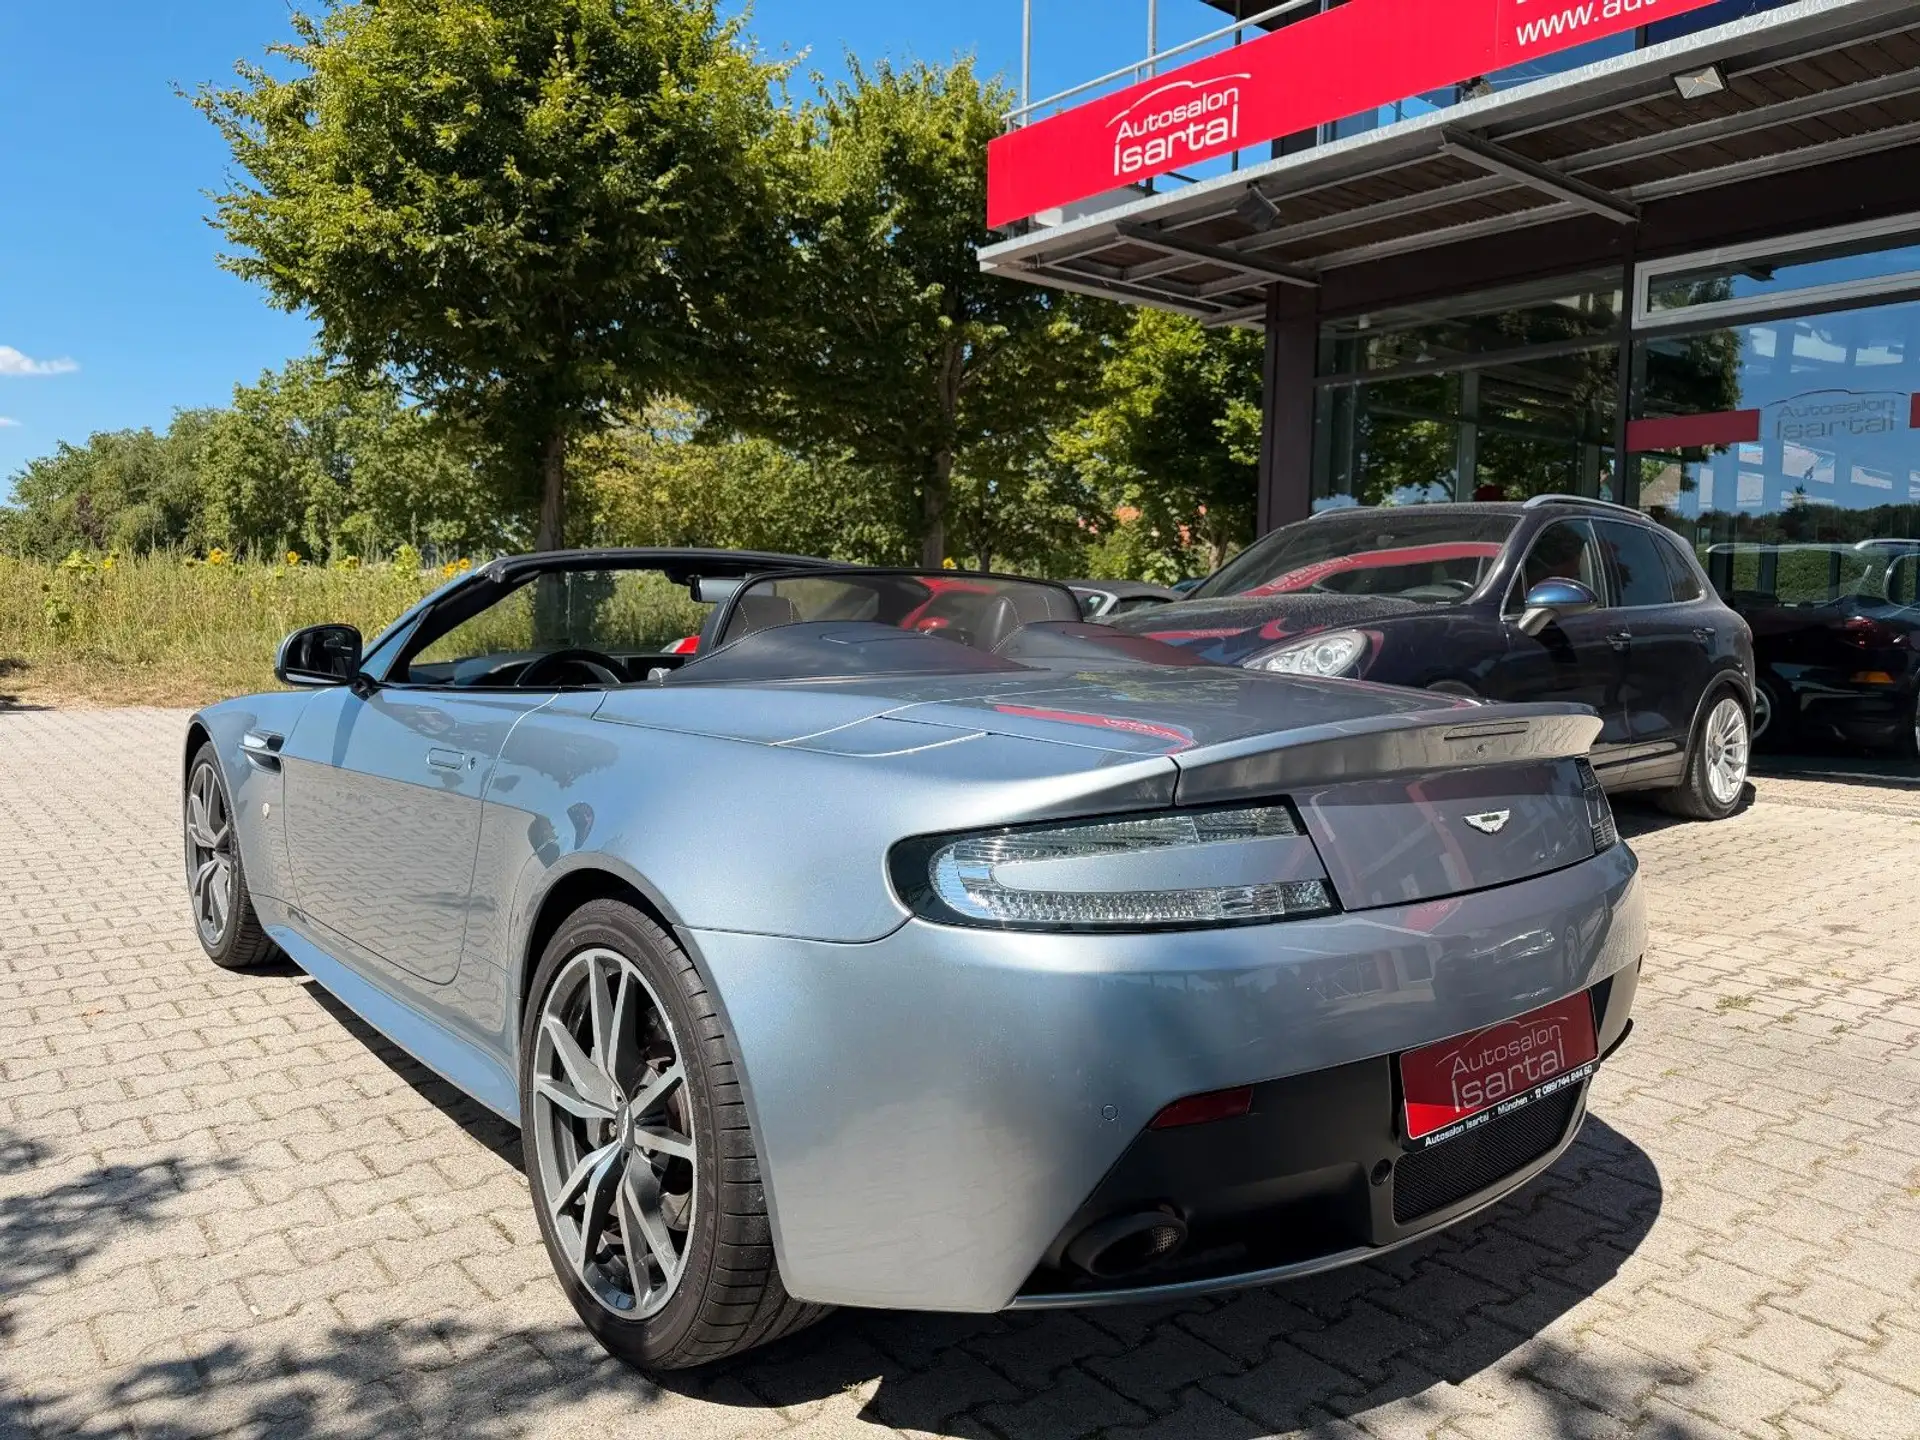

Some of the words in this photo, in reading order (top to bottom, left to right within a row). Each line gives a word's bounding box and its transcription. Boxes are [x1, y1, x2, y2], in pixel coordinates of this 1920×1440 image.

[1516, 0, 1657, 46] www.au
[1114, 104, 1239, 176] Isartal
[1116, 87, 1239, 143] Autosalon
[1776, 411, 1894, 441] Isartal
[1777, 398, 1896, 418] Autosalon
[1451, 1024, 1561, 1079] Autosalon
[1451, 1038, 1565, 1112] Isartal
[1425, 1125, 1464, 1147] Autosalon
[1465, 1112, 1489, 1129] Isartal
[1497, 1096, 1528, 1115] München
